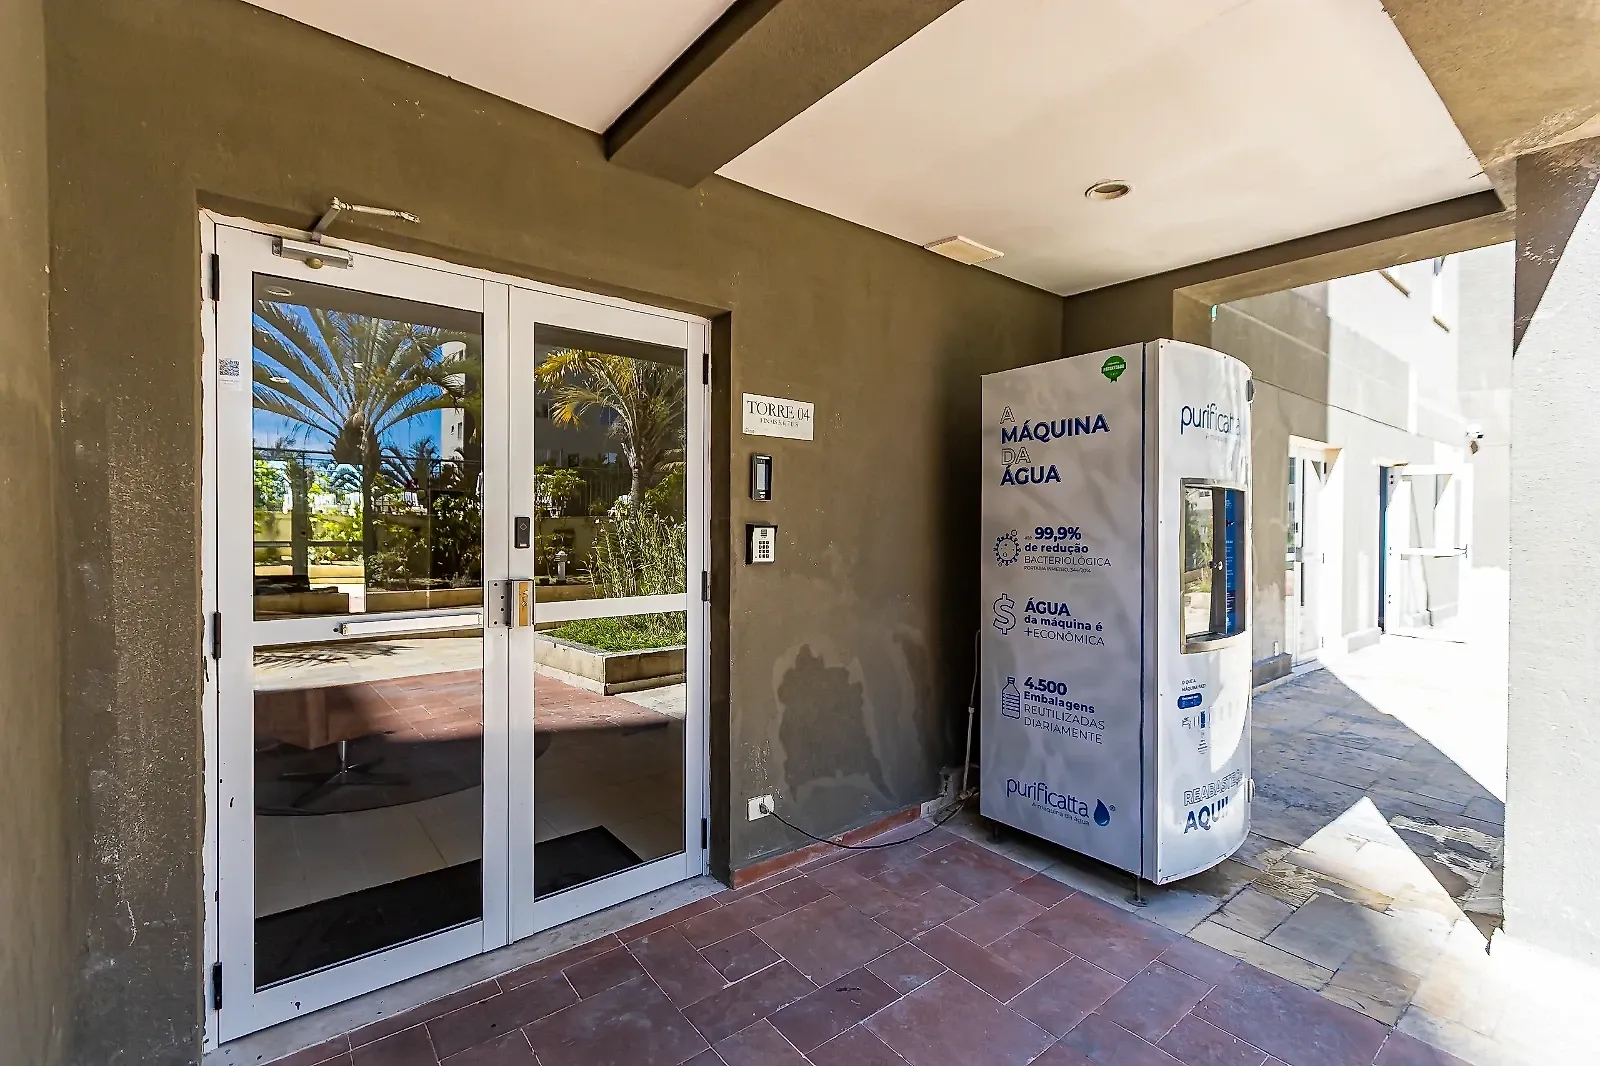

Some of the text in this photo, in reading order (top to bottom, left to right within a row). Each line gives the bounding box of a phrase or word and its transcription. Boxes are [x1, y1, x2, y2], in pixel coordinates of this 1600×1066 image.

[746, 400, 811, 421] TORRE 04
[1000, 406, 1015, 424] A
[1001, 413, 1111, 444] MÁQUINA
[1001, 446, 1032, 465] DA
[1000, 463, 1062, 486] ÁGUA
[1034, 526, 1082, 543] 99,9%
[1024, 542, 1089, 555] de redução
[1024, 555, 1112, 567] BACTERIOLÓGICA
[1024, 597, 1071, 617] ÁGUA
[1024, 614, 1103, 632] da máquina é
[1023, 627, 1105, 646] +ECONÔMICA
[1023, 676, 1068, 696] 4.500
[1023, 691, 1095, 714] Embalagens
[1024, 703, 1105, 731] REUTILIZADAS
[1024, 717, 1103, 745] DIARIAMENTE
[1006, 778, 1090, 819] purificatta
